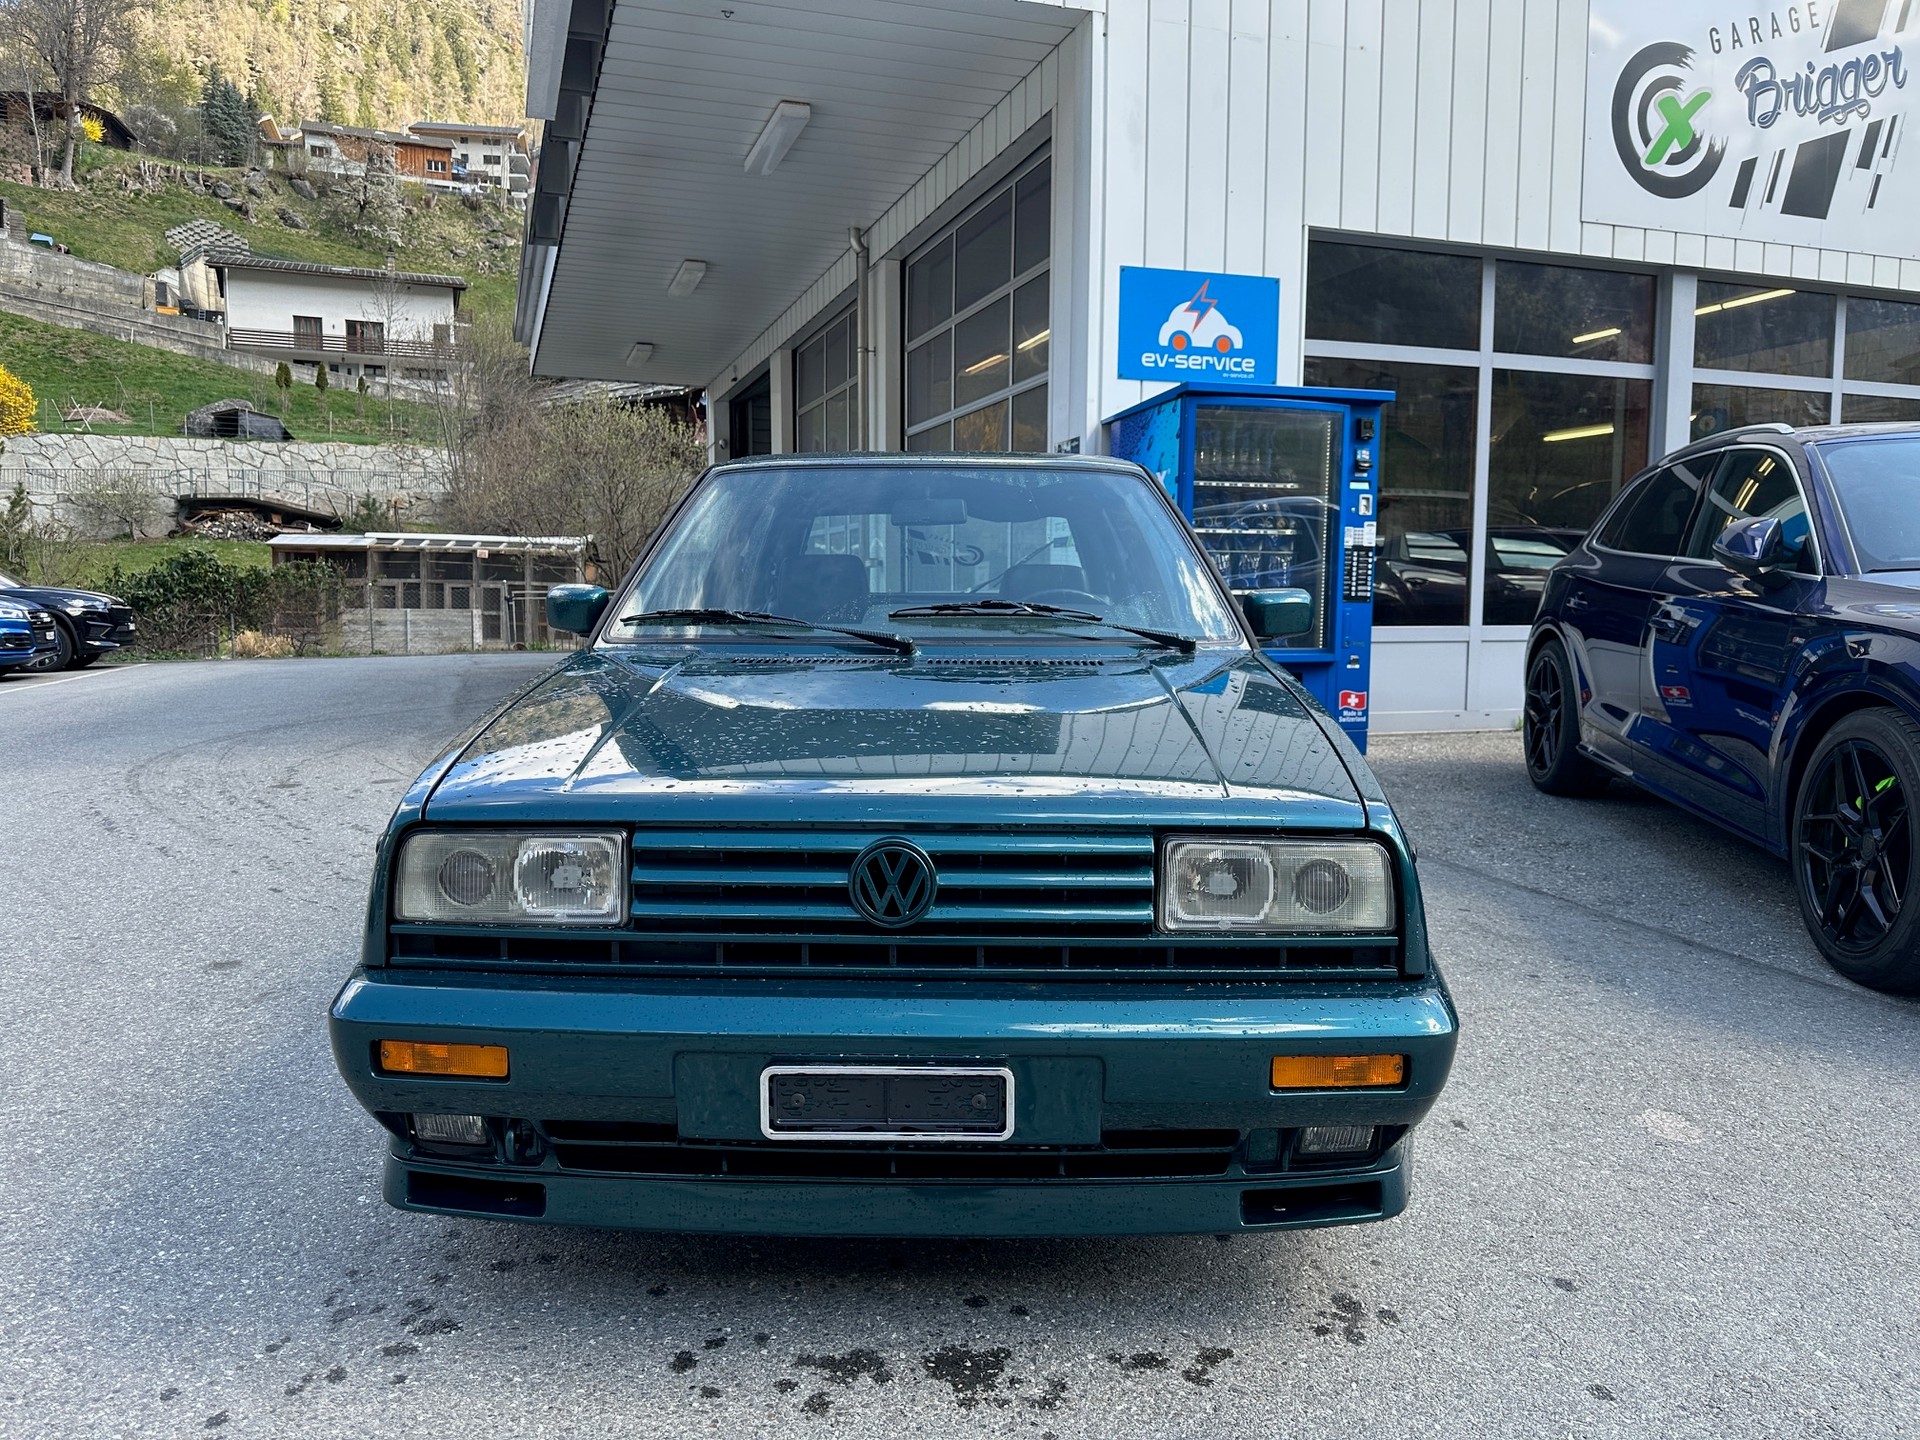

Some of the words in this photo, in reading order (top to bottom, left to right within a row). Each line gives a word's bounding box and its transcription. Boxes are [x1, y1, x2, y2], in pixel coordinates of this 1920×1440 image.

[1709, 1, 1820, 54] GARAGE
[1734, 45, 1908, 129] Brigger
[1141, 352, 1255, 372] ev-service
